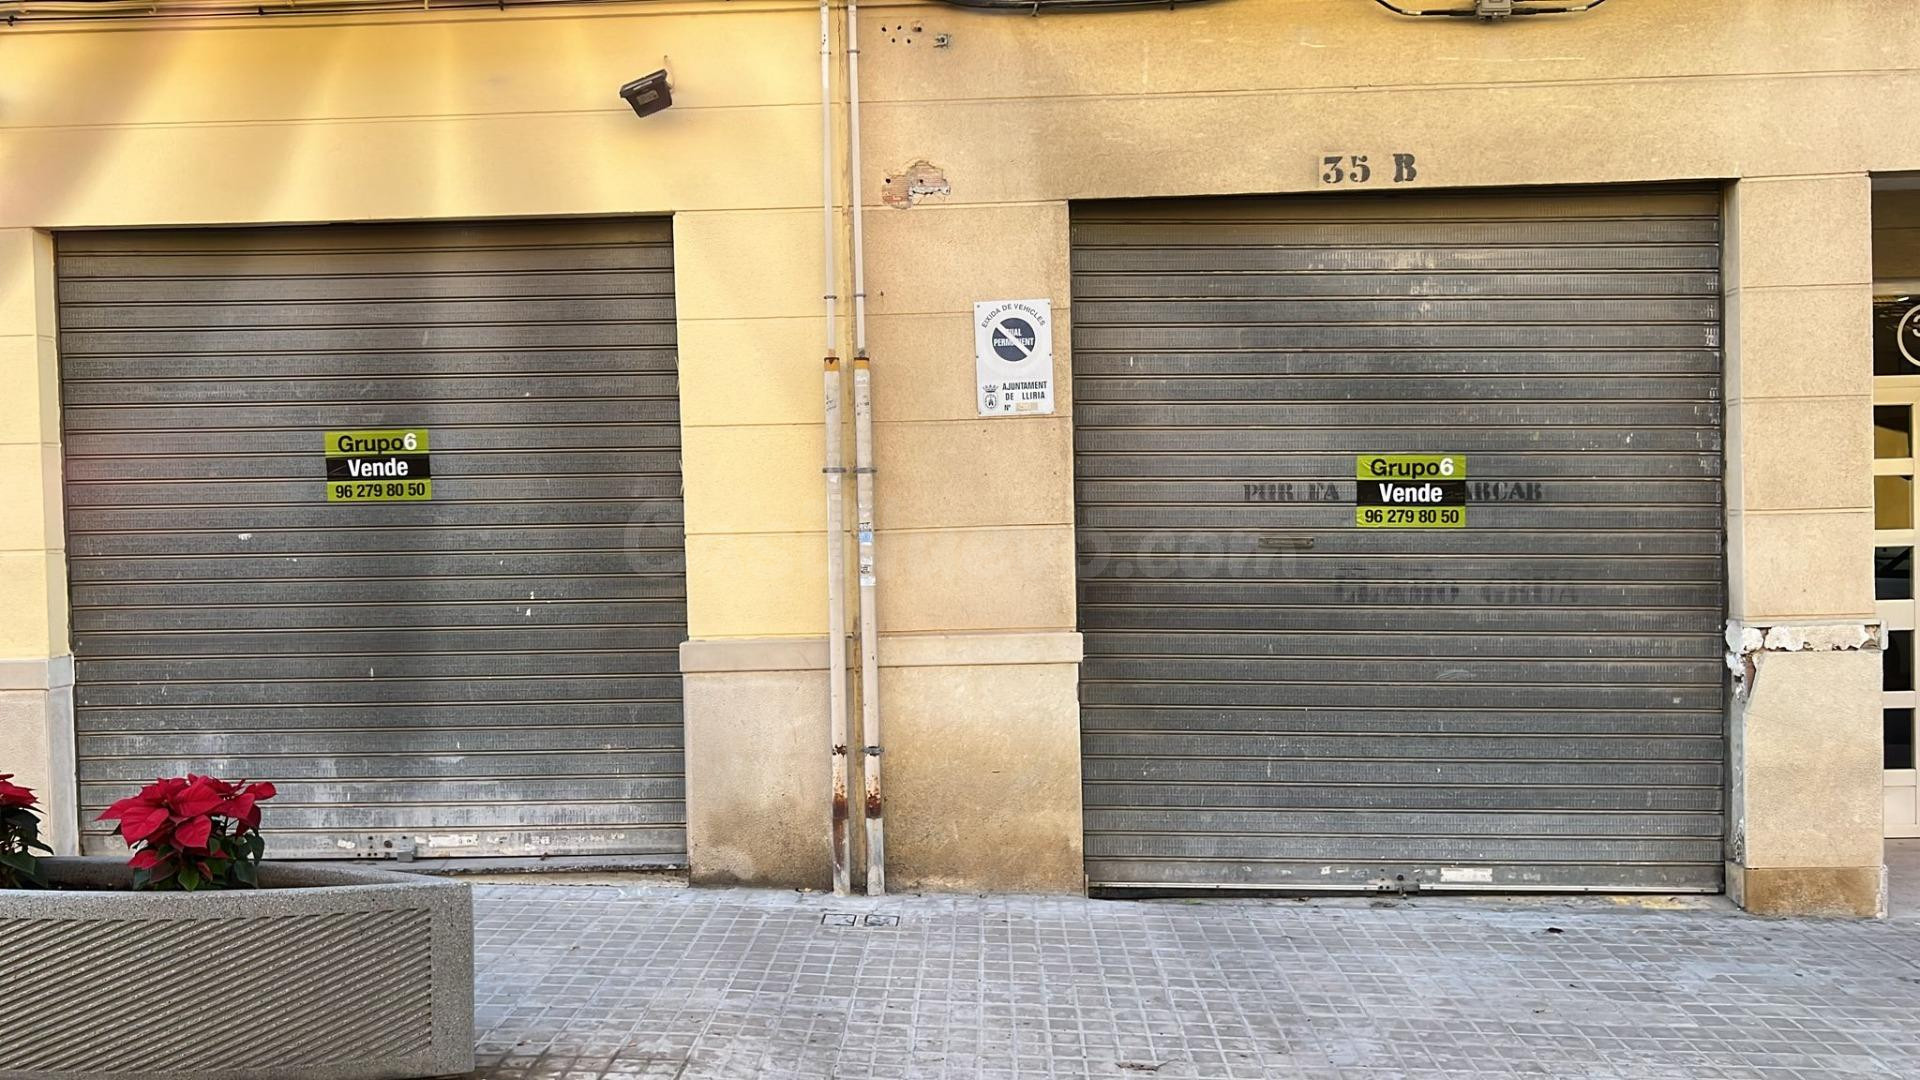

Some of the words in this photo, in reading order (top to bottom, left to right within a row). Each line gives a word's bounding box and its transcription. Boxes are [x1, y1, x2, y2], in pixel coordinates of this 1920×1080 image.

[1322, 155, 1371, 184] 35
[1392, 153, 1417, 183] B
[982, 308, 1001, 328] EIXIDA
[1013, 303, 1046, 326] VEHICLES
[993, 338, 1035, 347] PERMENT
[1002, 381, 1047, 391] AJUNTAMENT
[1005, 392, 1014, 401] DE
[1022, 391, 1045, 400] LLIRIA
[337, 432, 418, 455] Grupo6
[347, 458, 409, 477] Vende
[1370, 457, 1454, 479] Grupo6
[335, 484, 353, 498] 96
[356, 484, 383, 498] 279
[387, 483, 404, 497] 80
[408, 482, 426, 496] 50
[1379, 483, 1443, 503] Vende
[1365, 509, 1383, 523] 96
[1387, 509, 1415, 523] 279
[1418, 509, 1437, 523] 80
[1441, 509, 1460, 523] 50
